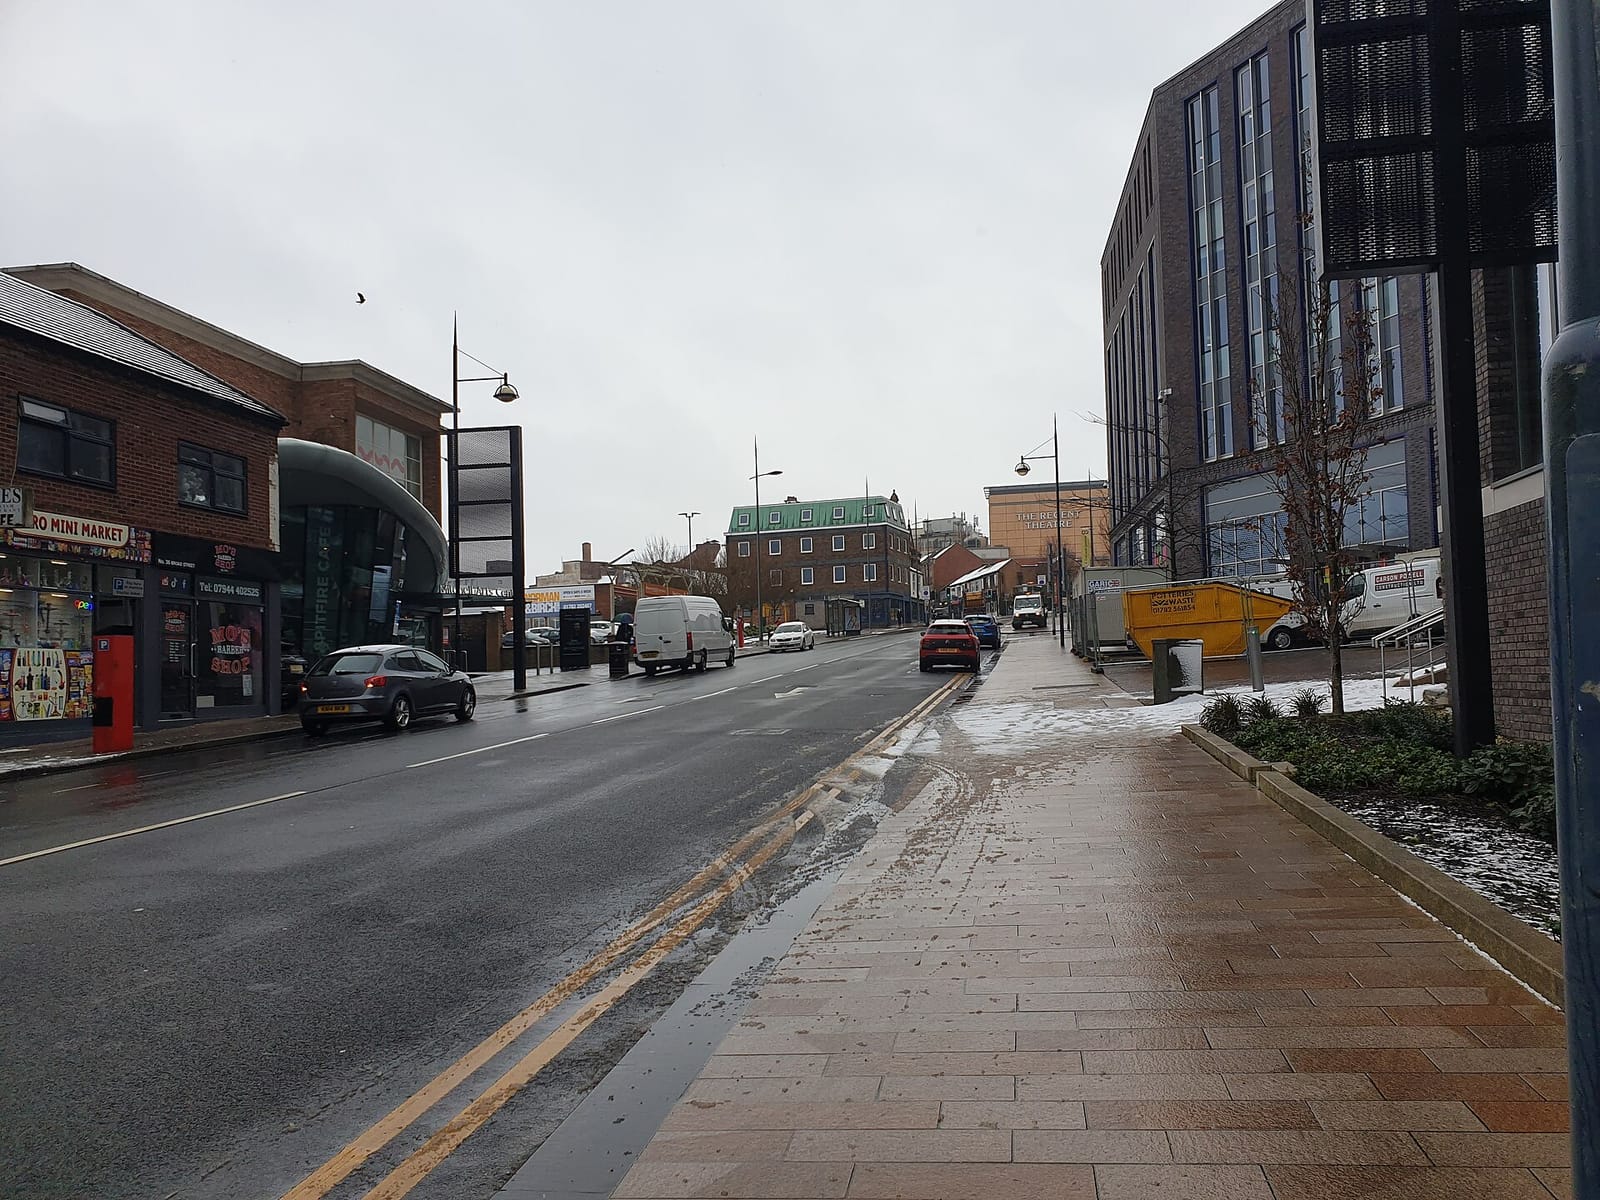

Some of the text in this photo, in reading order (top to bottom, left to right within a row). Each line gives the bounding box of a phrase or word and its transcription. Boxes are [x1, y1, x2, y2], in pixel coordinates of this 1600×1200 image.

[1016, 510, 1080, 521] THE REGENT
[1025, 520, 1073, 529] THEATRE
[51, 518, 79, 536] MINI
[82, 523, 123, 542] MARKET
[1376, 575, 1398, 583] CARSON
[1152, 590, 1194, 599] POTTERIES
[1169, 597, 1195, 605] WASTE
[210, 625, 251, 647] MO'S
[101, 641, 107, 649] P
[210, 657, 250, 674] SHOP
